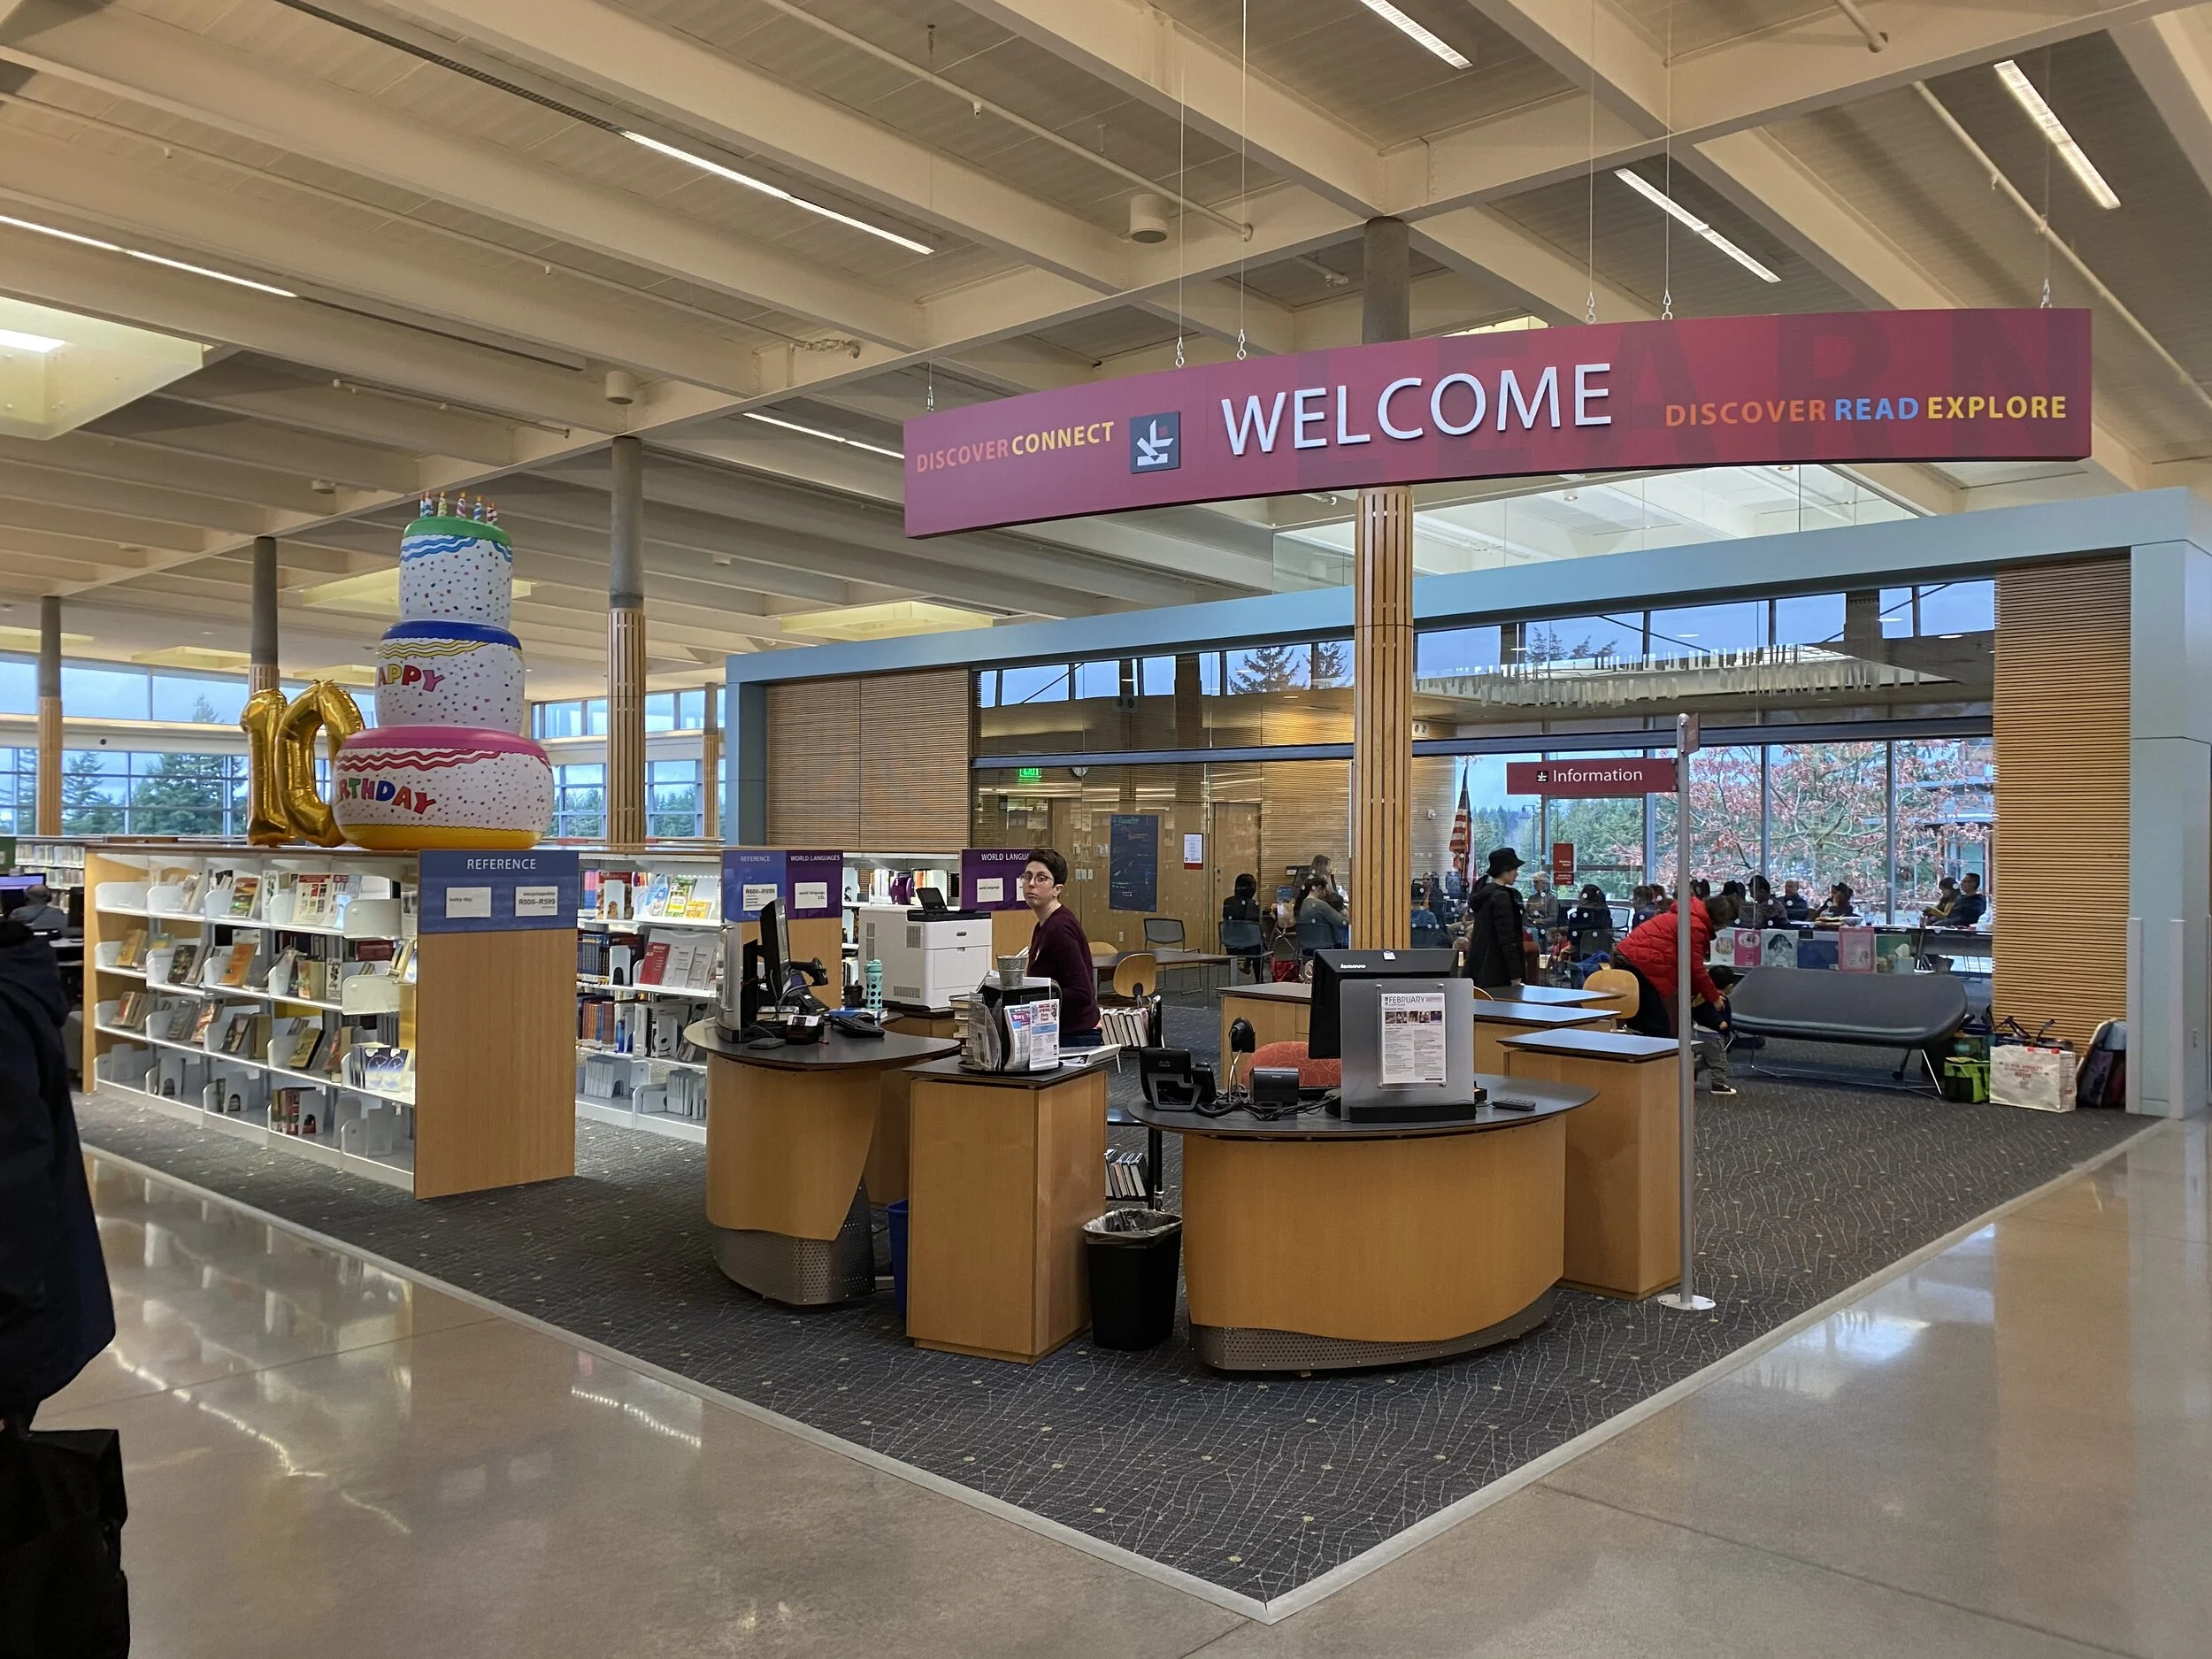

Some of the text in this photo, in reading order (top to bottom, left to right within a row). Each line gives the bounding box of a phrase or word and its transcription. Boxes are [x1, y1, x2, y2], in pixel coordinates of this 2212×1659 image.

[1221, 362, 1612, 457] WELCOME
[1665, 395, 2067, 427] DISCOVER READ EXPLORE
[917, 420, 1115, 472] DISCOVER CONNECT
[377, 663, 446, 693] APPY
[1553, 768, 1643, 783] Information
[338, 777, 436, 815] RTHDAY
[467, 858, 537, 870] REFERENCE
